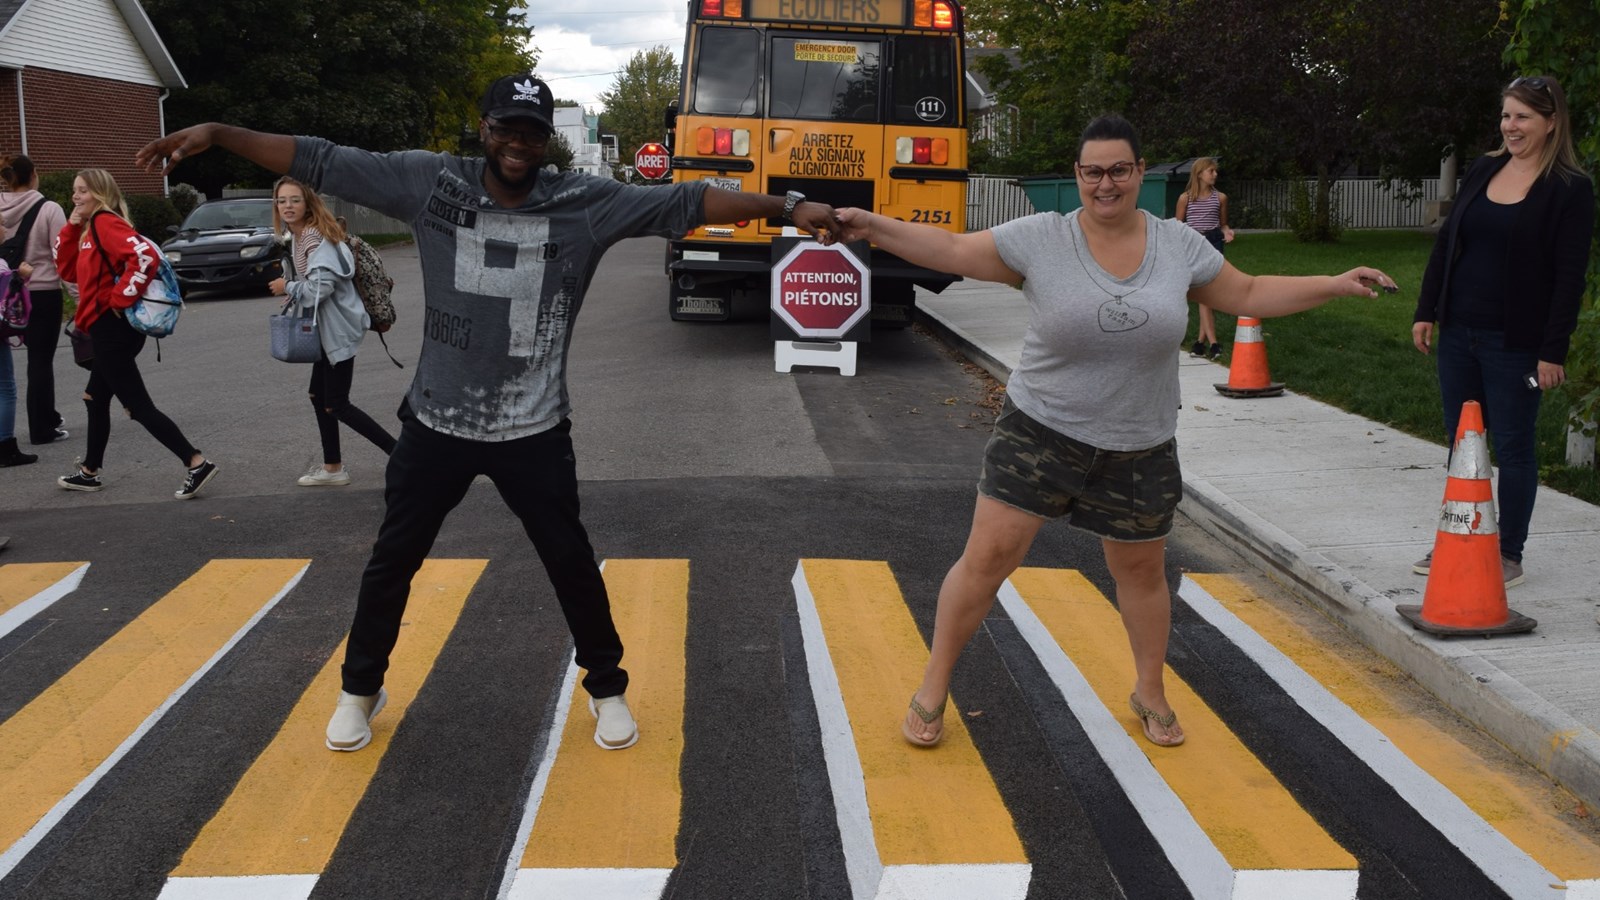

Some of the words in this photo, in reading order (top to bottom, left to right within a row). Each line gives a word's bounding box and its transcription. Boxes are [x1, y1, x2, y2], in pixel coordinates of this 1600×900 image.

[796, 43, 836, 52] EMERGENCY
[837, 45, 856, 54] DOOR
[827, 54, 856, 62] SECOURS
[512, 94, 540, 105] adidas
[920, 101, 939, 112] 111
[802, 133, 853, 148] ARRETEZ
[790, 147, 813, 161] AUX
[817, 148, 865, 163] SIGNAUX
[789, 161, 865, 177] CLIGNOTANTS
[910, 209, 952, 224] 2151
[543, 242, 559, 260] 19
[784, 272, 857, 285] ATTENTION,
[784, 289, 858, 306] PIÉTONS!
